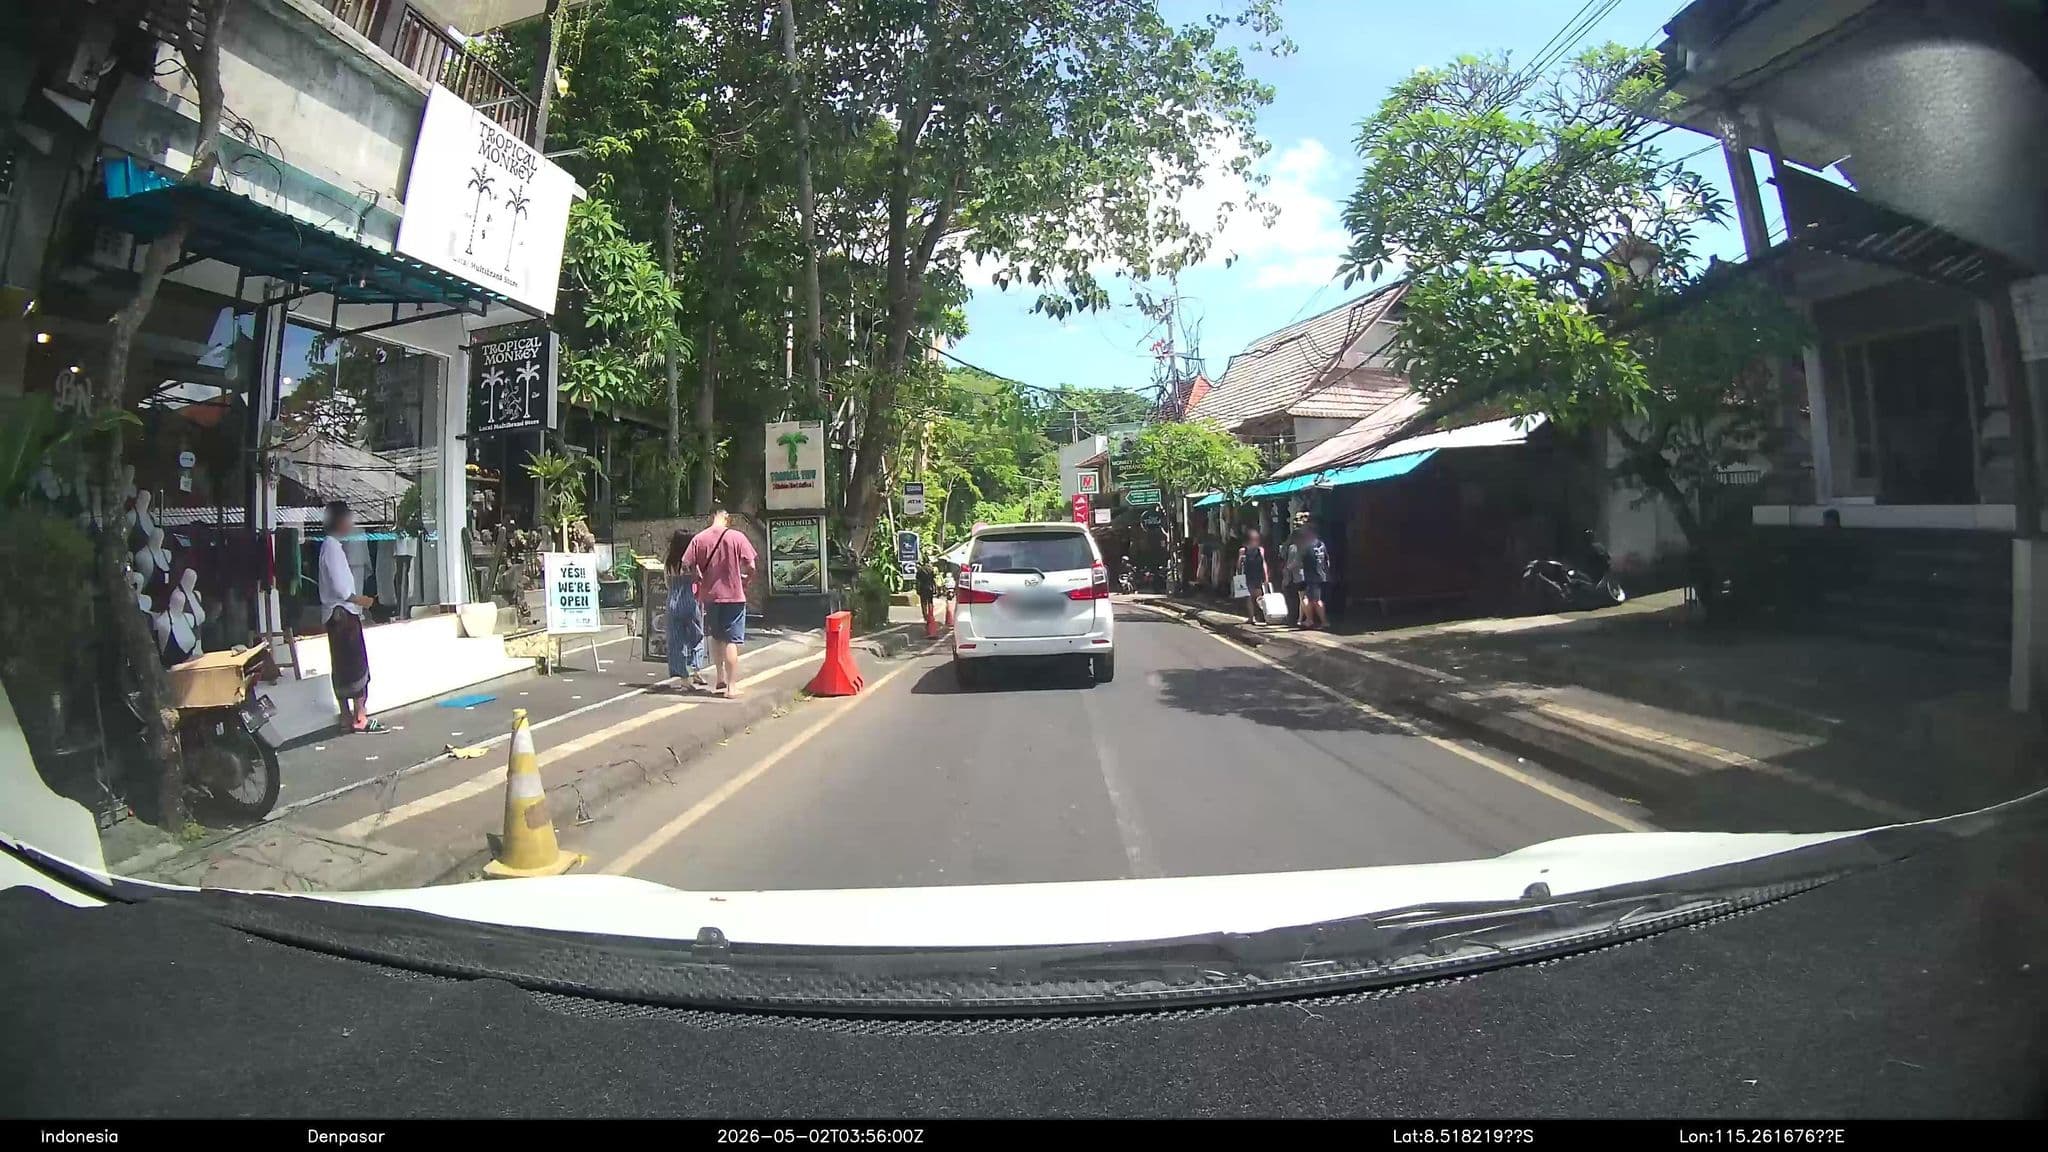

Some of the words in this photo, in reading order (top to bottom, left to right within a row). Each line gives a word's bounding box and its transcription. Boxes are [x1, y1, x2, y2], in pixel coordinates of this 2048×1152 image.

[479, 121, 537, 172] TROPICAL
[478, 139, 535, 184] MONKEY
[482, 337, 542, 356] TROPICAL
[484, 347, 539, 366] MONKEY
[560, 567, 586, 579] YES!!
[558, 581, 591, 593] WE'RE
[560, 596, 589, 607] OPEN
